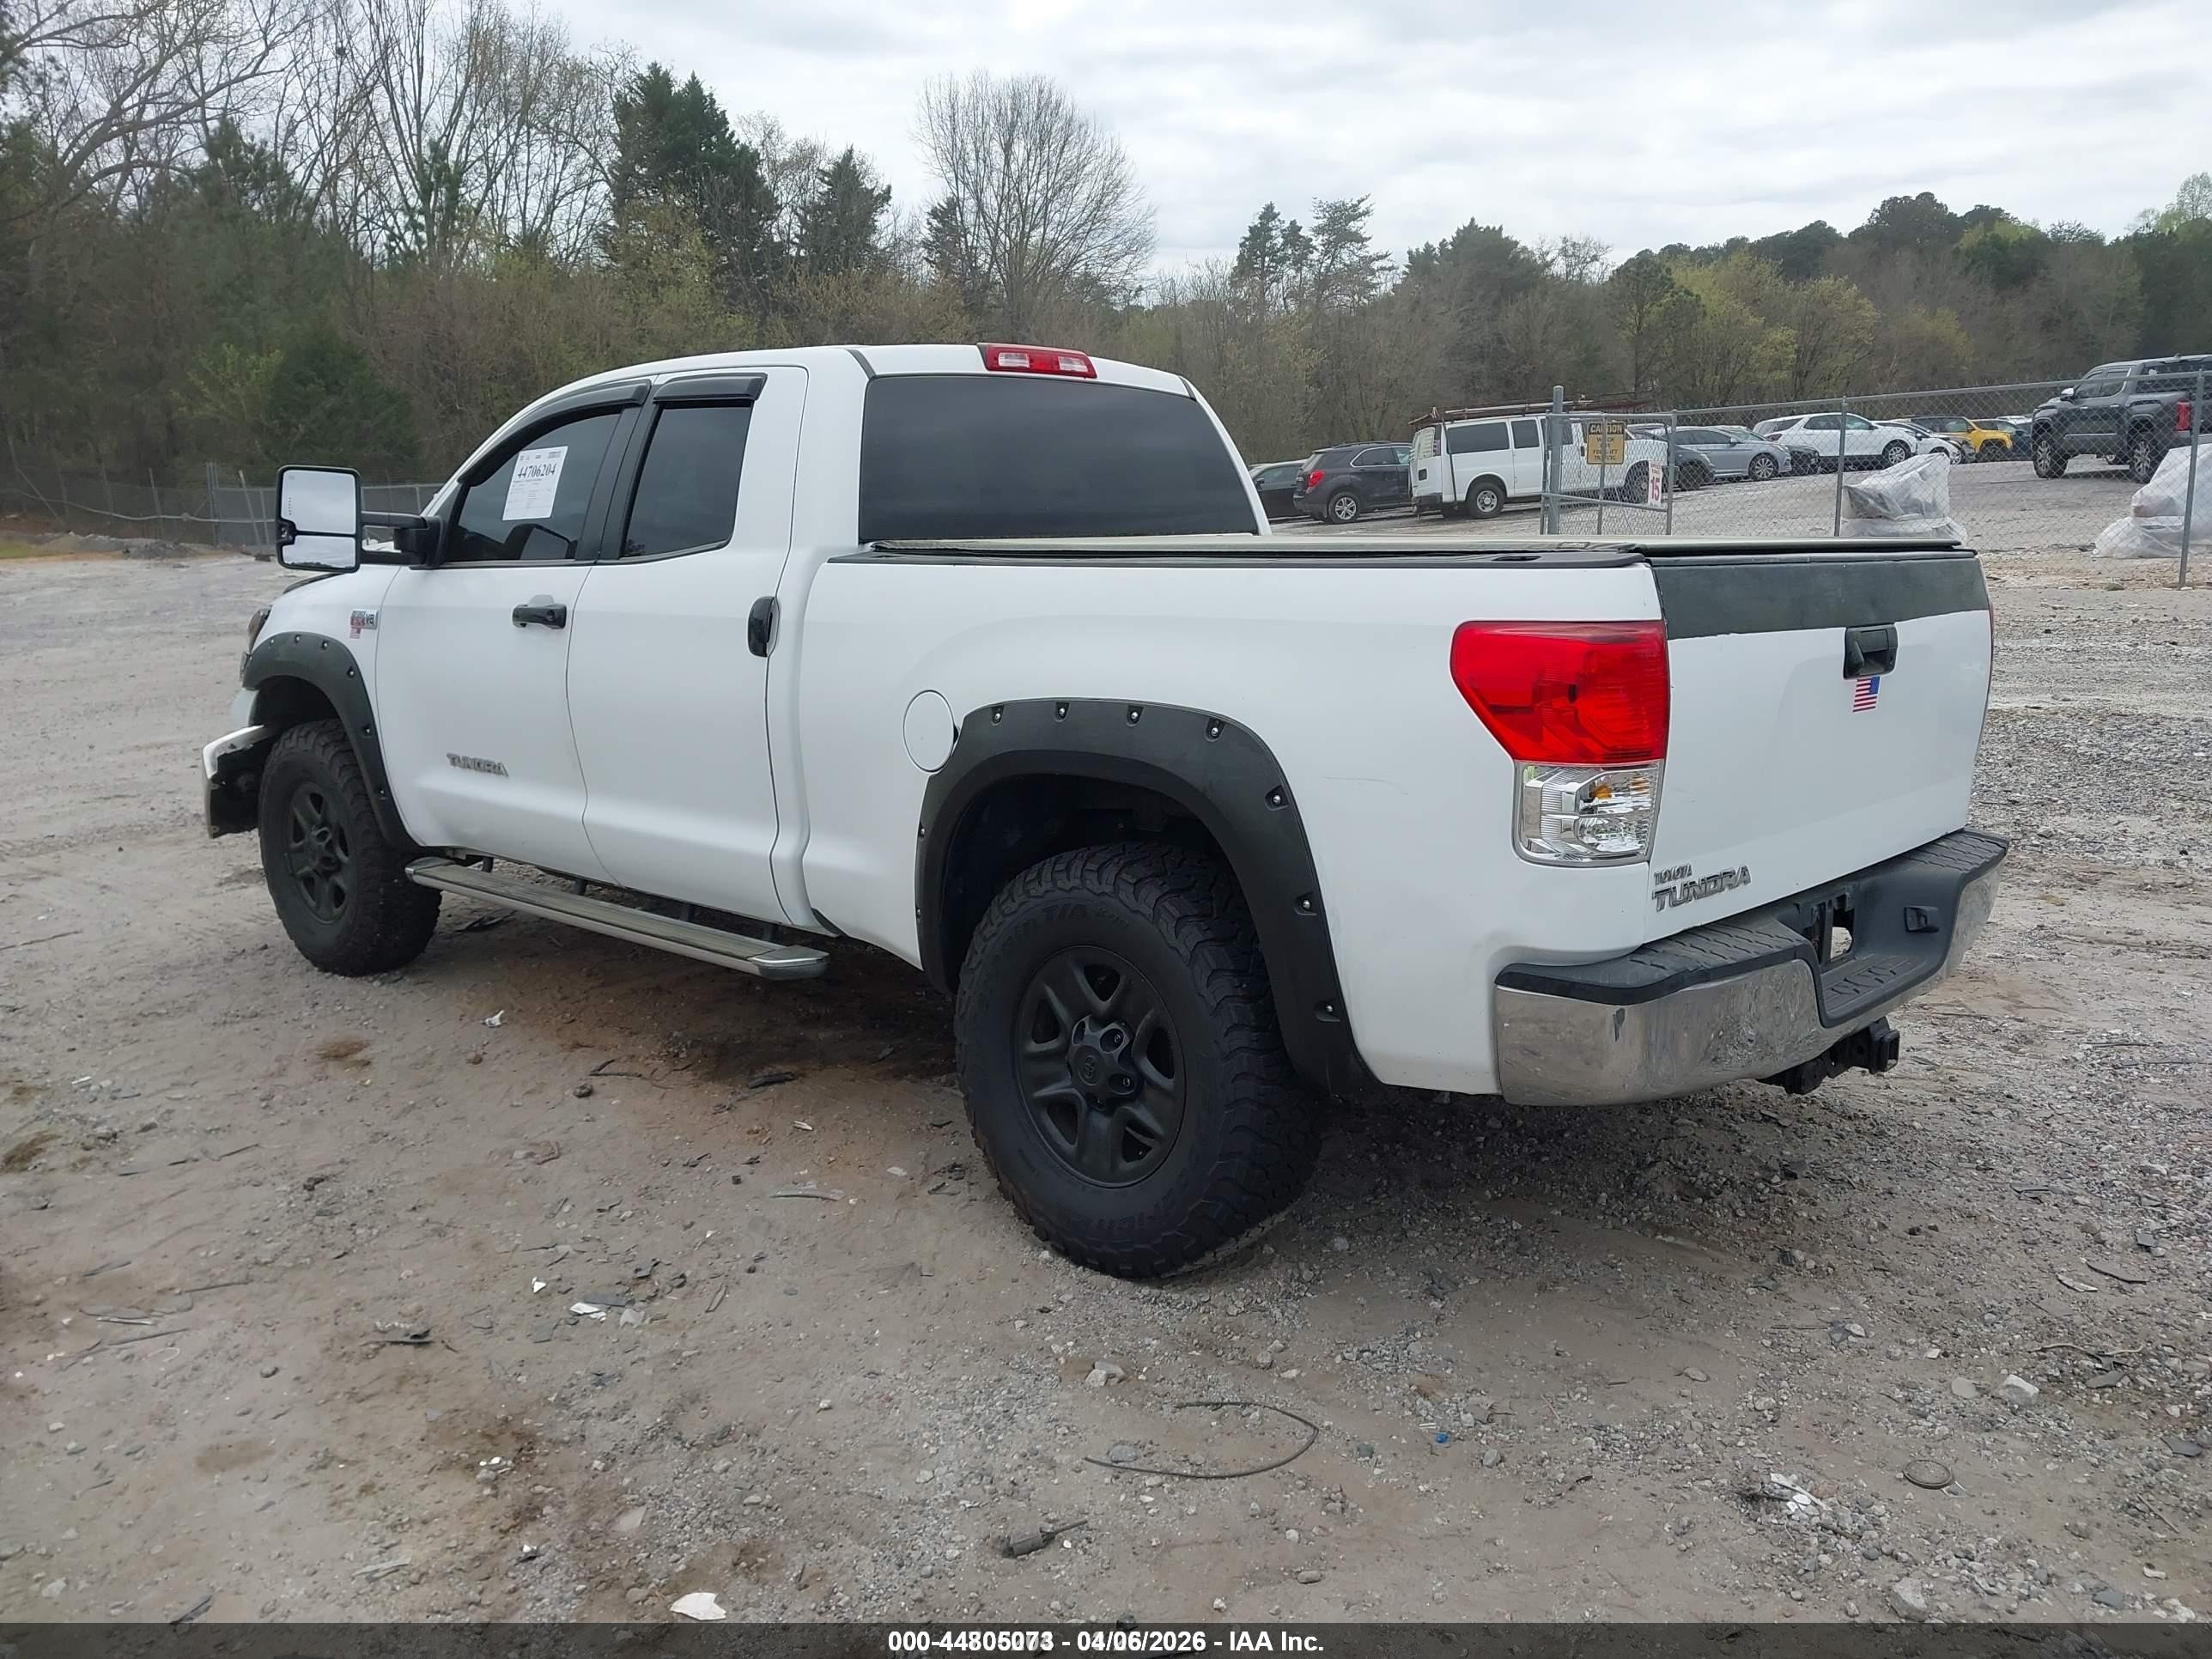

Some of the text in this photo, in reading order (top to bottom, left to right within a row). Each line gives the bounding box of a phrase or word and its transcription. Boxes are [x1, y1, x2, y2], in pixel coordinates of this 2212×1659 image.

[1590, 424, 1623, 434] CAION
[517, 463, 556, 478] 44706204
[1650, 477, 1660, 501] 15
[447, 752, 508, 777] TUNDRA
[1654, 863, 1692, 886] TOYOTA
[1651, 865, 1752, 913] TUNDRA
